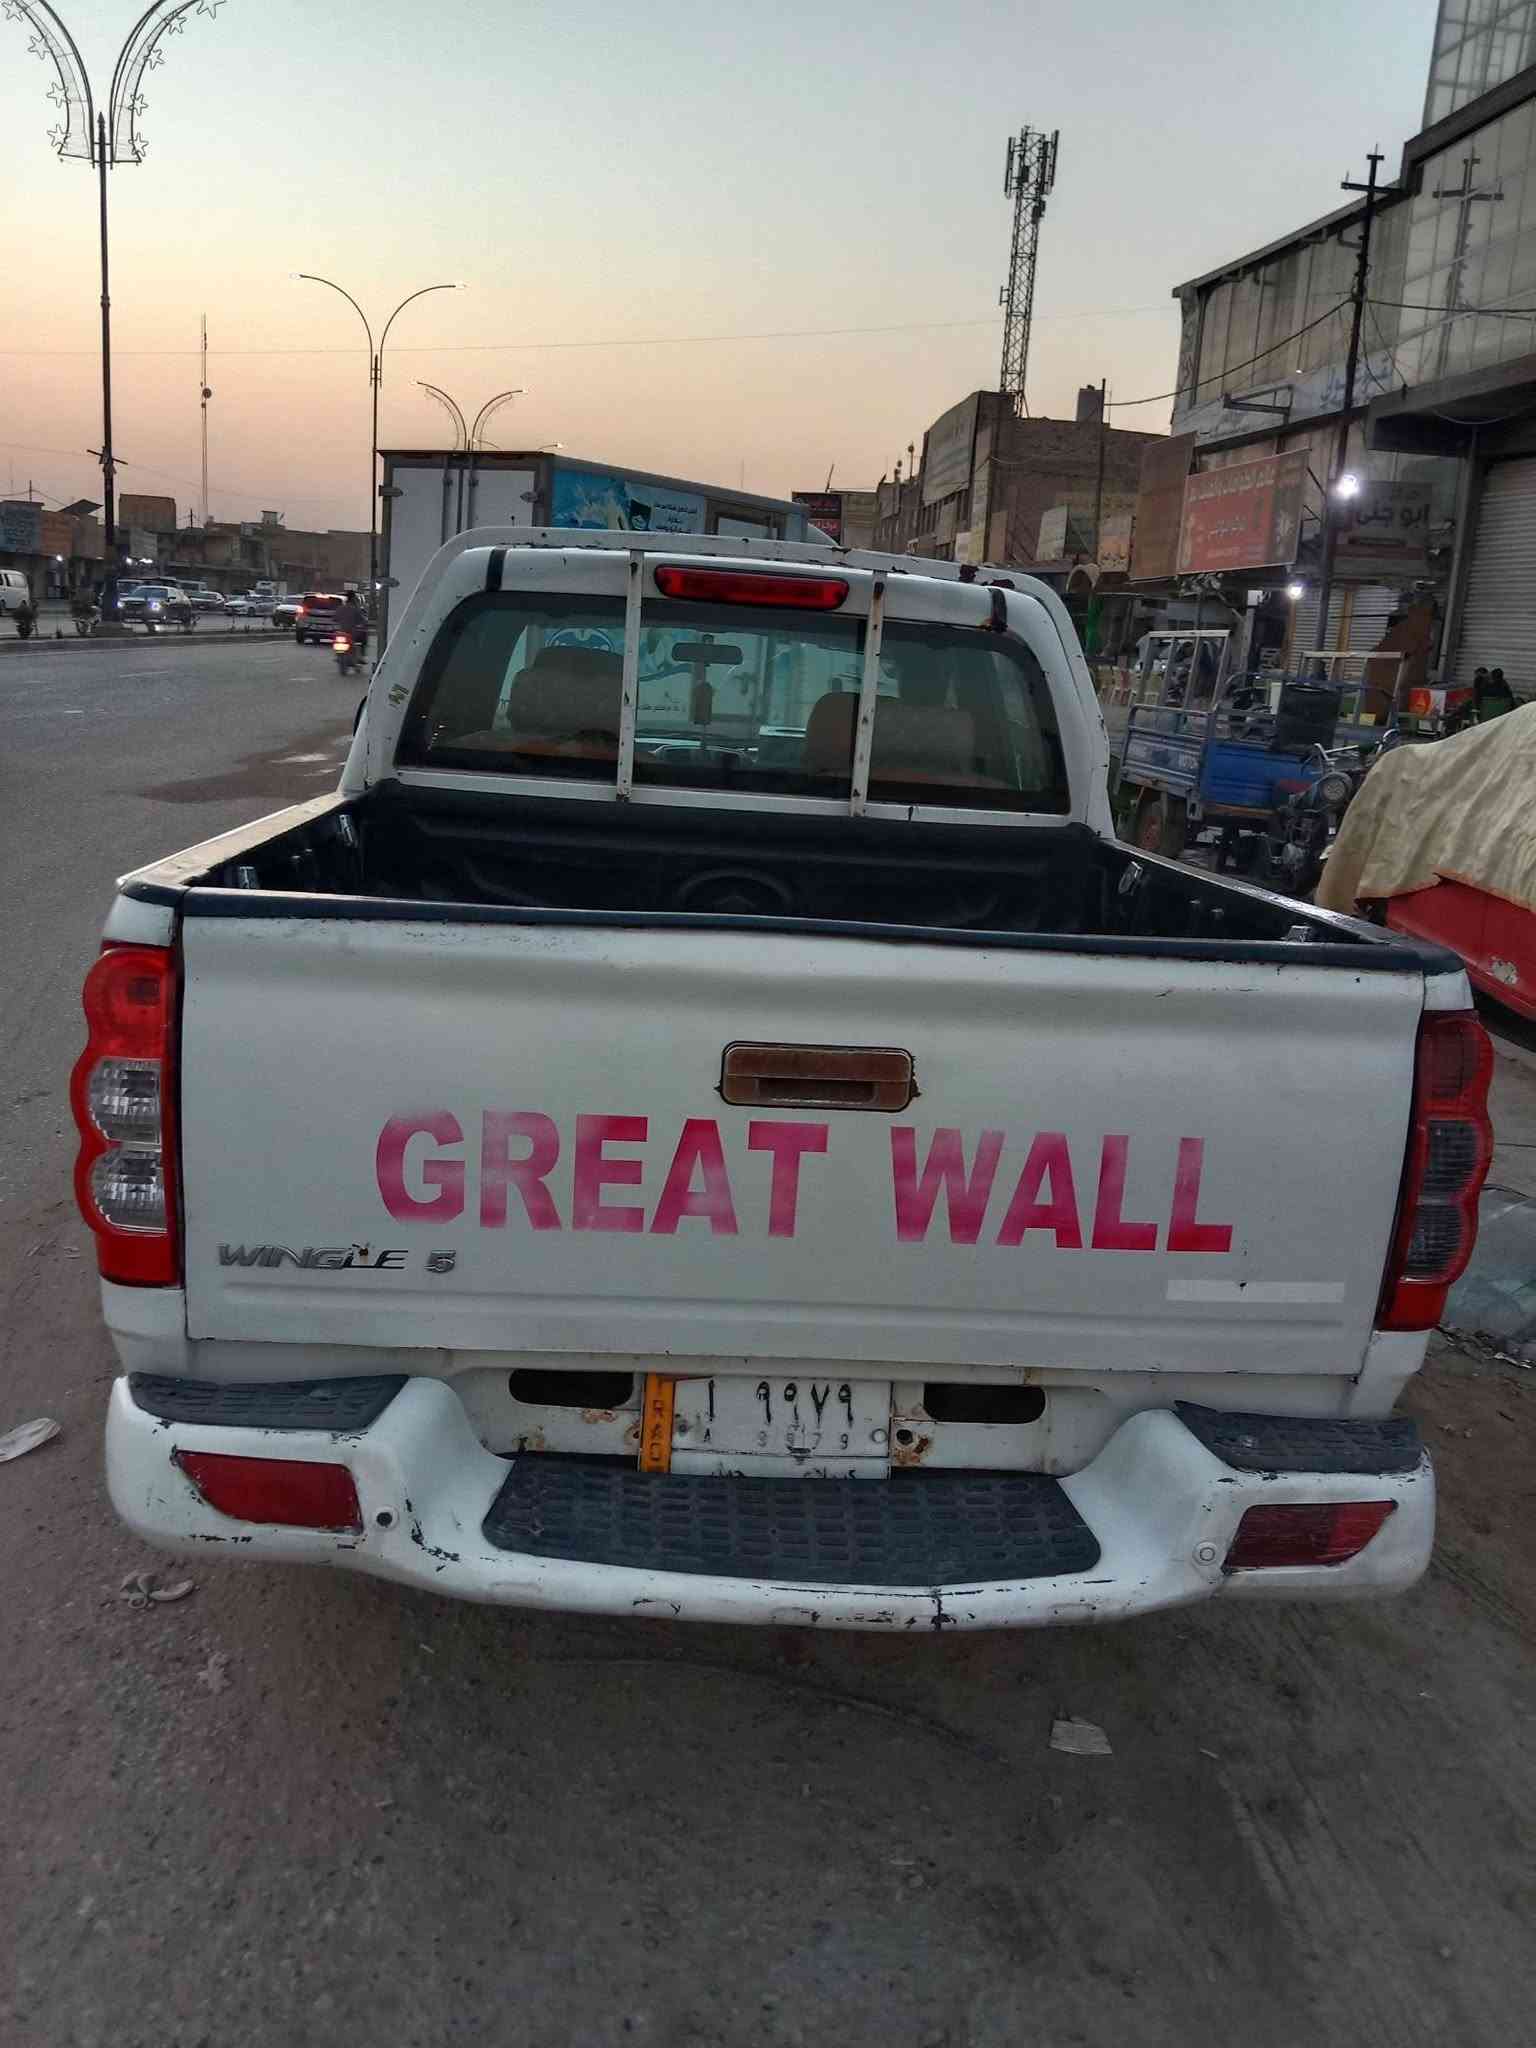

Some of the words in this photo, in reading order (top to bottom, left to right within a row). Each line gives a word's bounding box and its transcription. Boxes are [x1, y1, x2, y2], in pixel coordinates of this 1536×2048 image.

[377, 1111, 829, 1237] GREAT
[891, 1128, 1233, 1255] WALL
[218, 1243, 408, 1270] WINGLE
[424, 1249, 457, 1273] 5
